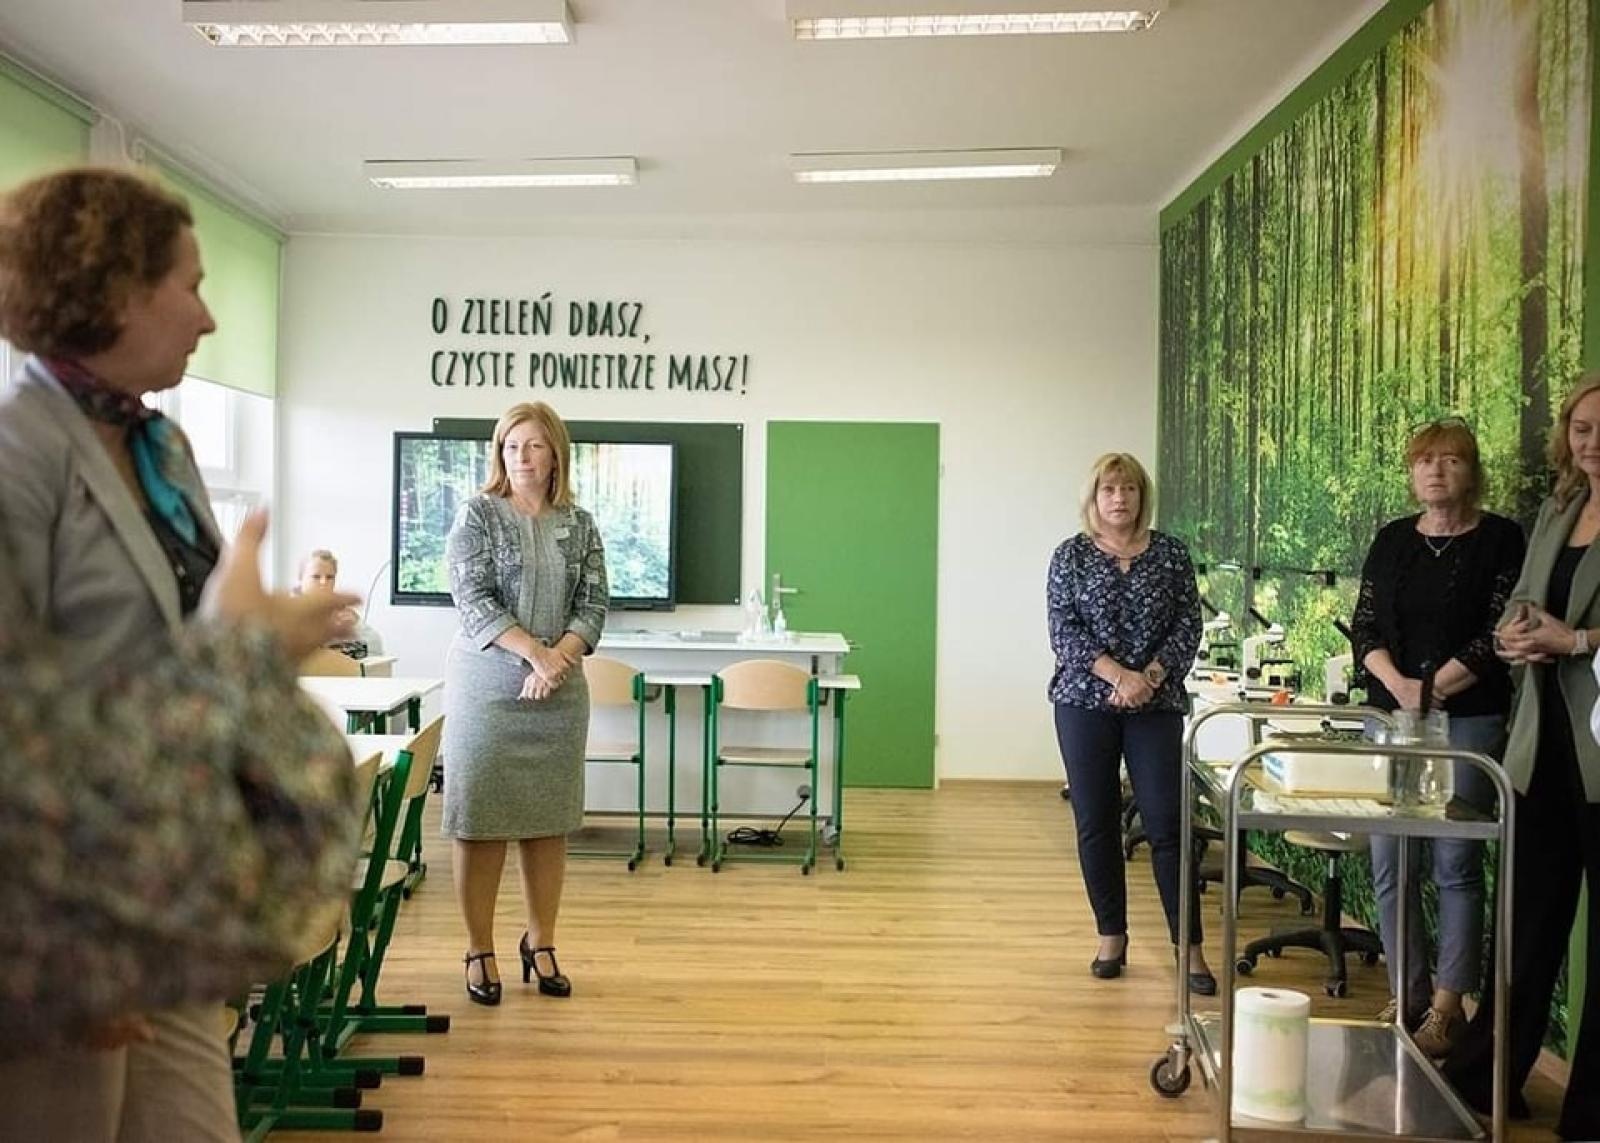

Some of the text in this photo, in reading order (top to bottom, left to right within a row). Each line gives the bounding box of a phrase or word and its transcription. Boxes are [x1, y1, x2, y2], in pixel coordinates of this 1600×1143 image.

[431, 291, 651, 343] O ZIELEŃ DBASZ,
[431, 351, 749, 395] CZYSTE POWIETRZE MASZ!
